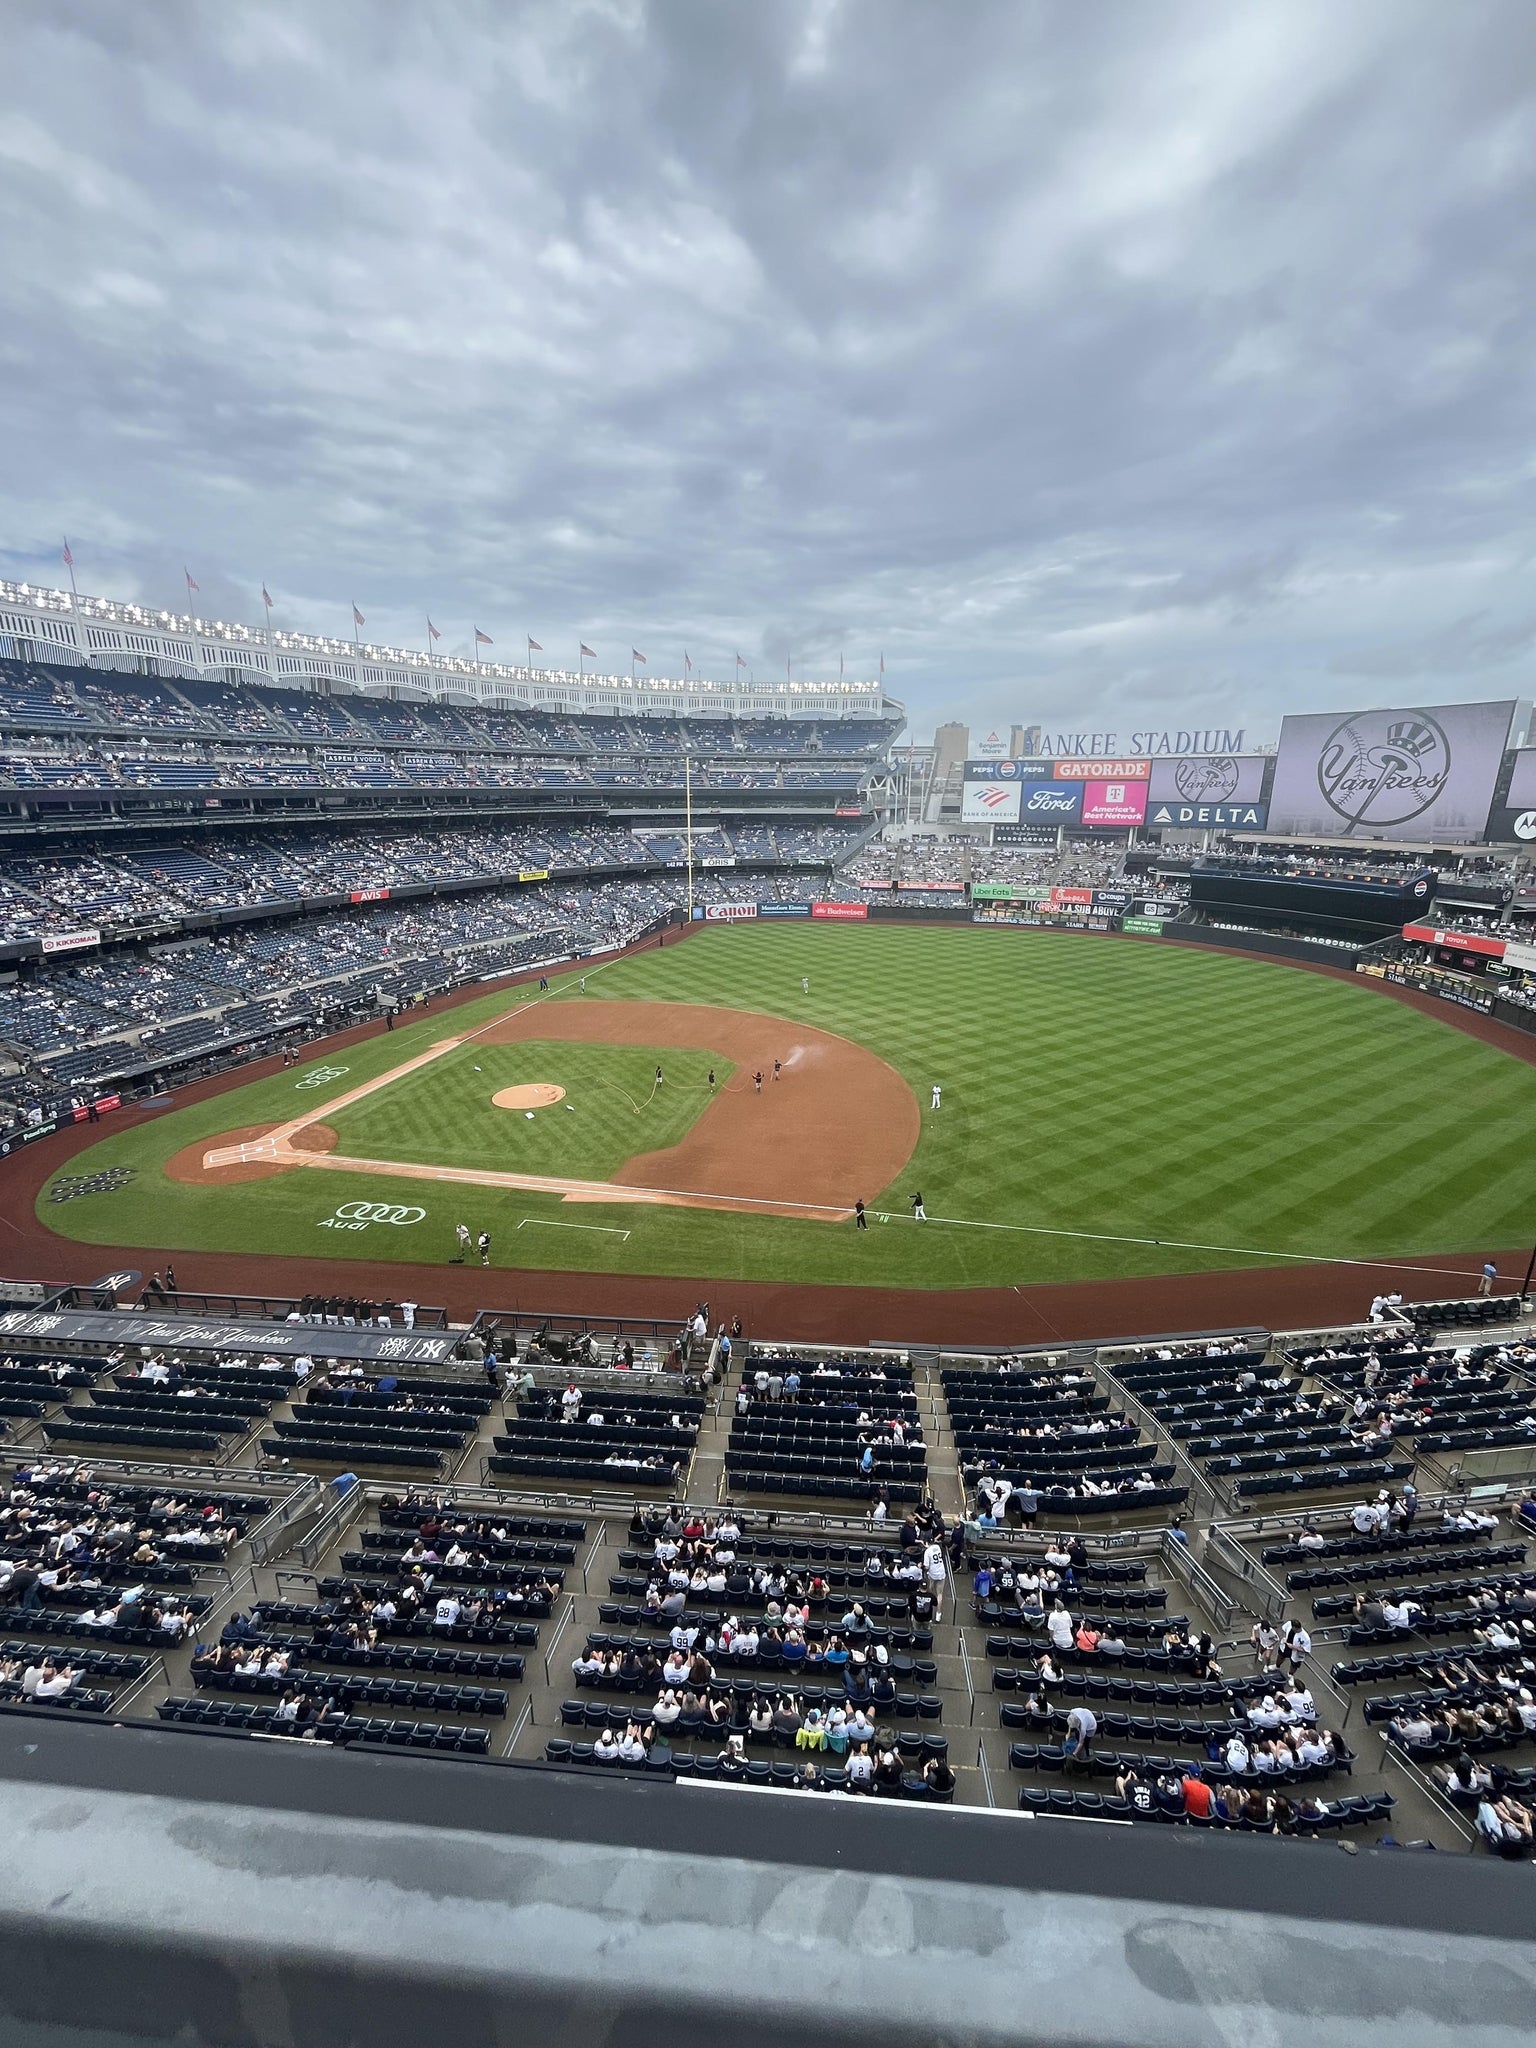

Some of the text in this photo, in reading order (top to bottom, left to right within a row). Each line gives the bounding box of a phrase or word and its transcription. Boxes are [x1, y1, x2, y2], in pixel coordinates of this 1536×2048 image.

[1026, 729, 1246, 756] YANKEE STADIUM
[1060, 762, 1146, 776] GATORADE
[1322, 744, 1441, 796] Yankees
[1027, 790, 1077, 810] Ford
[1179, 808, 1258, 824] DELTA
[360, 891, 382, 901] AVIS
[974, 888, 991, 896] Uber
[992, 888, 1010, 896] Eats
[1106, 893, 1126, 901] coupa
[706, 906, 756, 918] Canon
[827, 907, 865, 916] Budweiser
[1066, 904, 1073, 912] A
[1073, 905, 1091, 915] SUB
[1092, 905, 1120, 917] ABOVE
[56, 935, 97, 947] KIKKOMAN
[1445, 936, 1468, 945] TOYOTA
[1387, 973, 1406, 985] STARR
[317, 1218, 370, 1231] Audi
[140, 1322, 293, 1347] New York Yankees
[932, 1553, 943, 1565] 99
[672, 1579, 684, 1588] 99
[1001, 1578, 1014, 1587] 99
[438, 1606, 450, 1618] 28
[676, 1637, 688, 1647] 99
[1302, 1701, 1315, 1714] 99
[1233, 1743, 1246, 1756] 22
[858, 1766, 864, 1776] 2
[1134, 1794, 1150, 1809] 42
